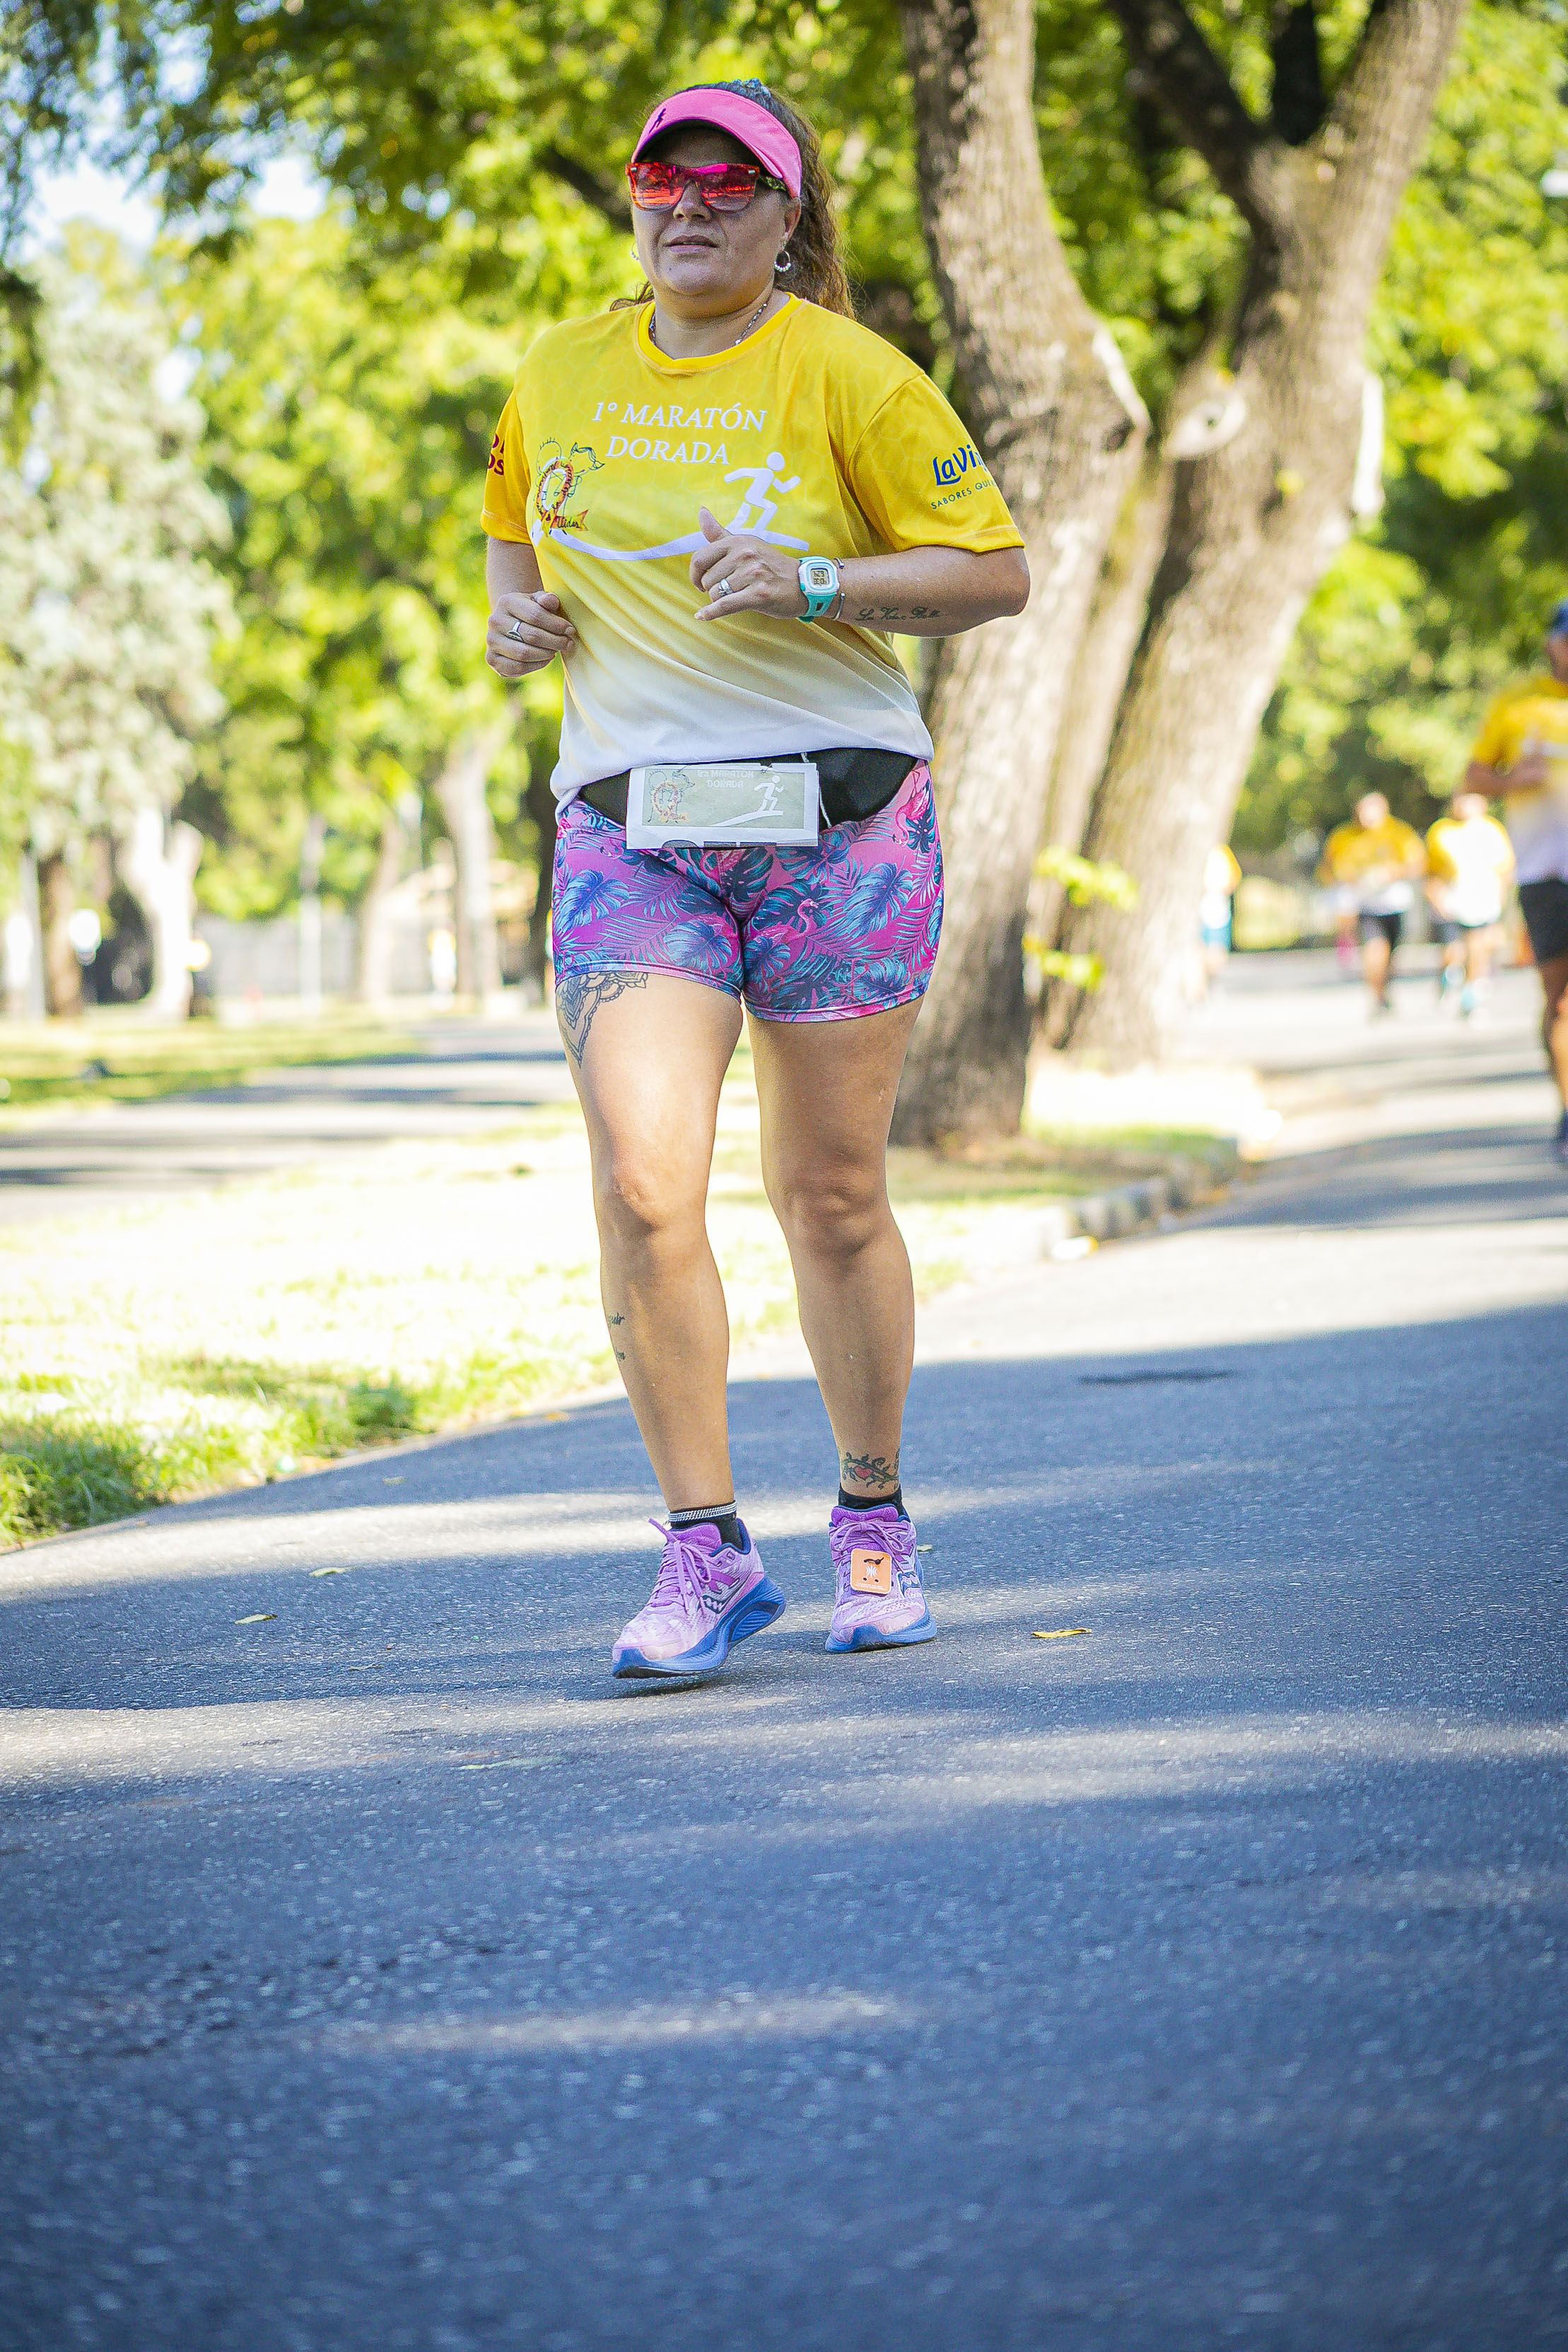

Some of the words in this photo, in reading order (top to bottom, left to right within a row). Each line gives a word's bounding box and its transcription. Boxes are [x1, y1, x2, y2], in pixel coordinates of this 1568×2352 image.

[621, 402, 768, 432] MARATÓN
[605, 435, 730, 465] DORADA
[930, 487, 972, 510] SABORES
[707, 780, 744, 788] DORADA
